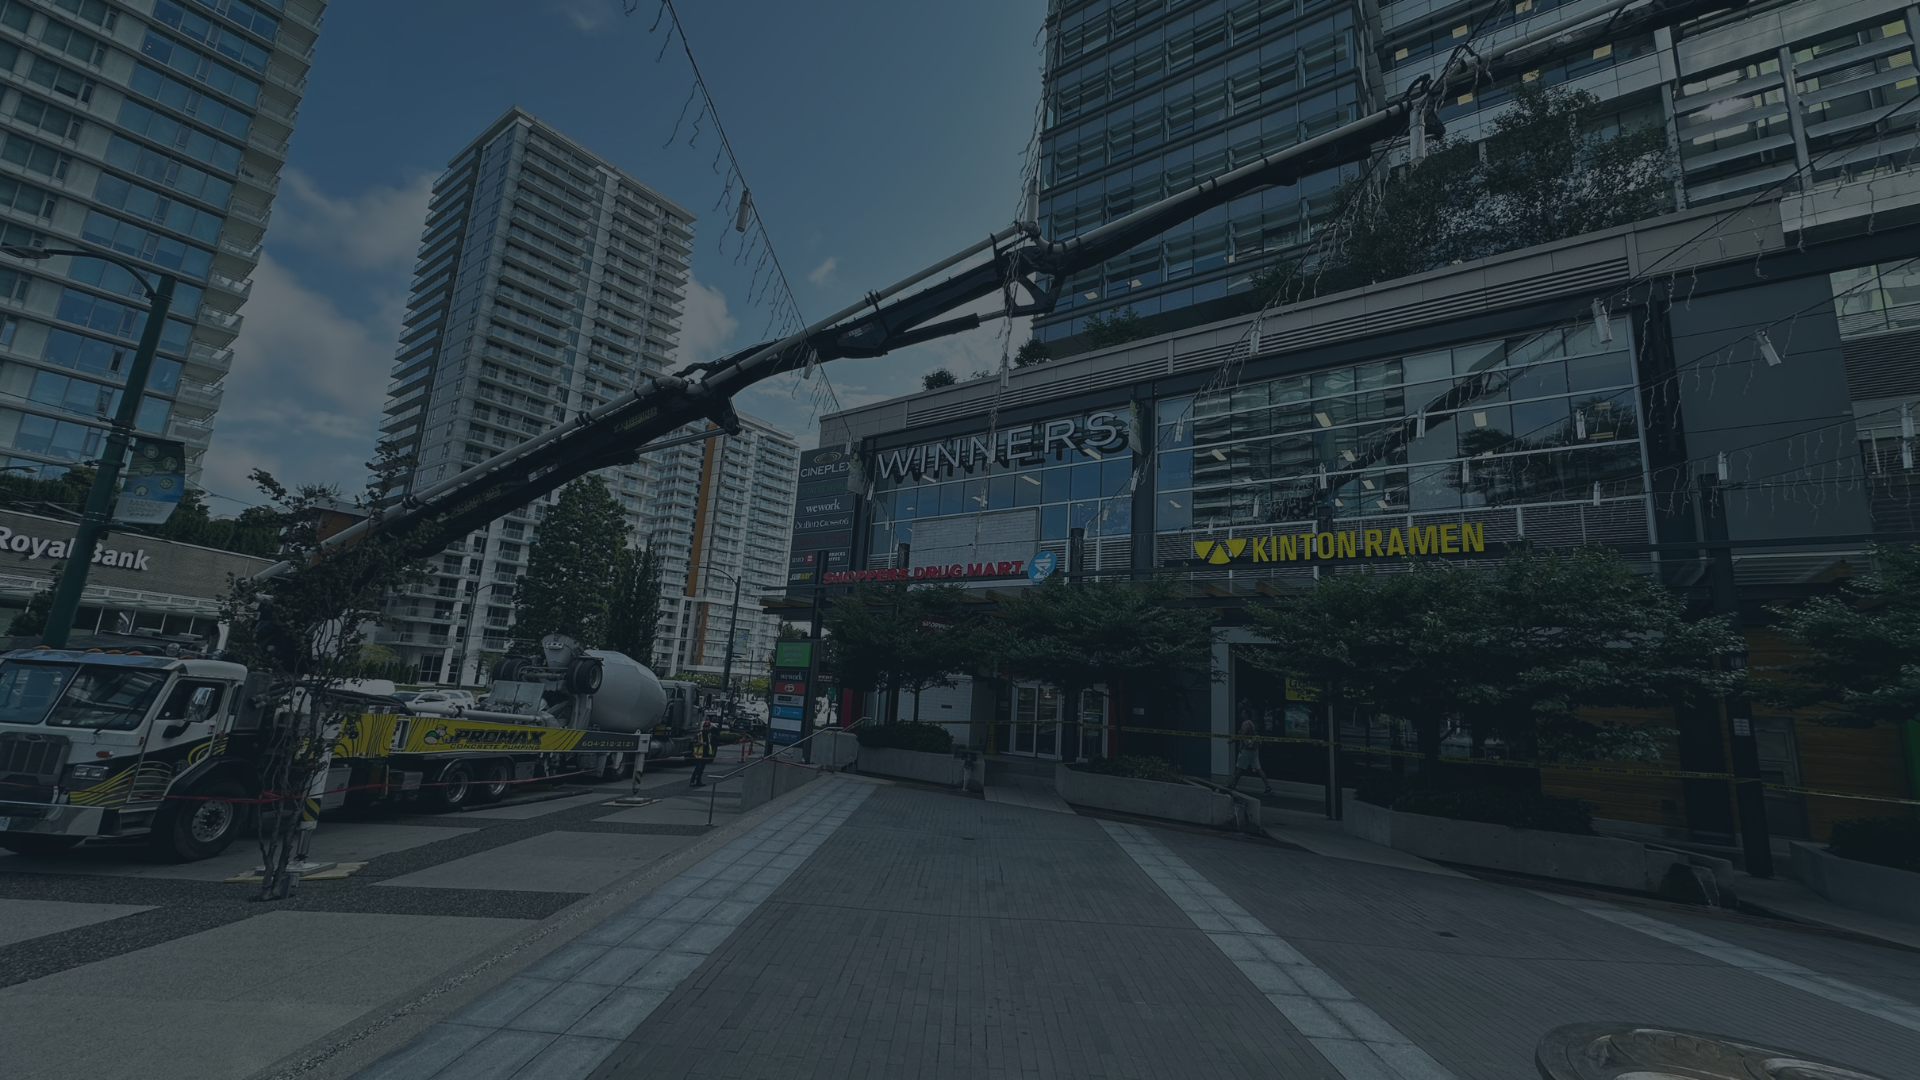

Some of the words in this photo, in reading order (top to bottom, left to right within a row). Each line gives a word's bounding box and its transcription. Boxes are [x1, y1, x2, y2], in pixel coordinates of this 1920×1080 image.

[878, 411, 1118, 479] WINNERS
[800, 462, 851, 478] CINEPLEX
[800, 485, 826, 496] FITNESS
[129, 499, 167, 509] MARINE
[805, 498, 841, 513] wework
[0, 526, 76, 560] Royal
[91, 542, 150, 570] Bank
[1252, 530, 1356, 563] KINTON
[1364, 522, 1485, 557] RAMEN
[789, 571, 814, 582] SUBWAY
[822, 567, 910, 585] SHOPPERS
[913, 563, 962, 580] DRUG
[966, 560, 1025, 577] MART
[780, 671, 803, 681] wework
[453, 728, 546, 744] PROMAX
[1390, 749, 1412, 757] CAUTION
[1534, 762, 1560, 770] CAUTION
[1774, 785, 1809, 793] CAUTION
